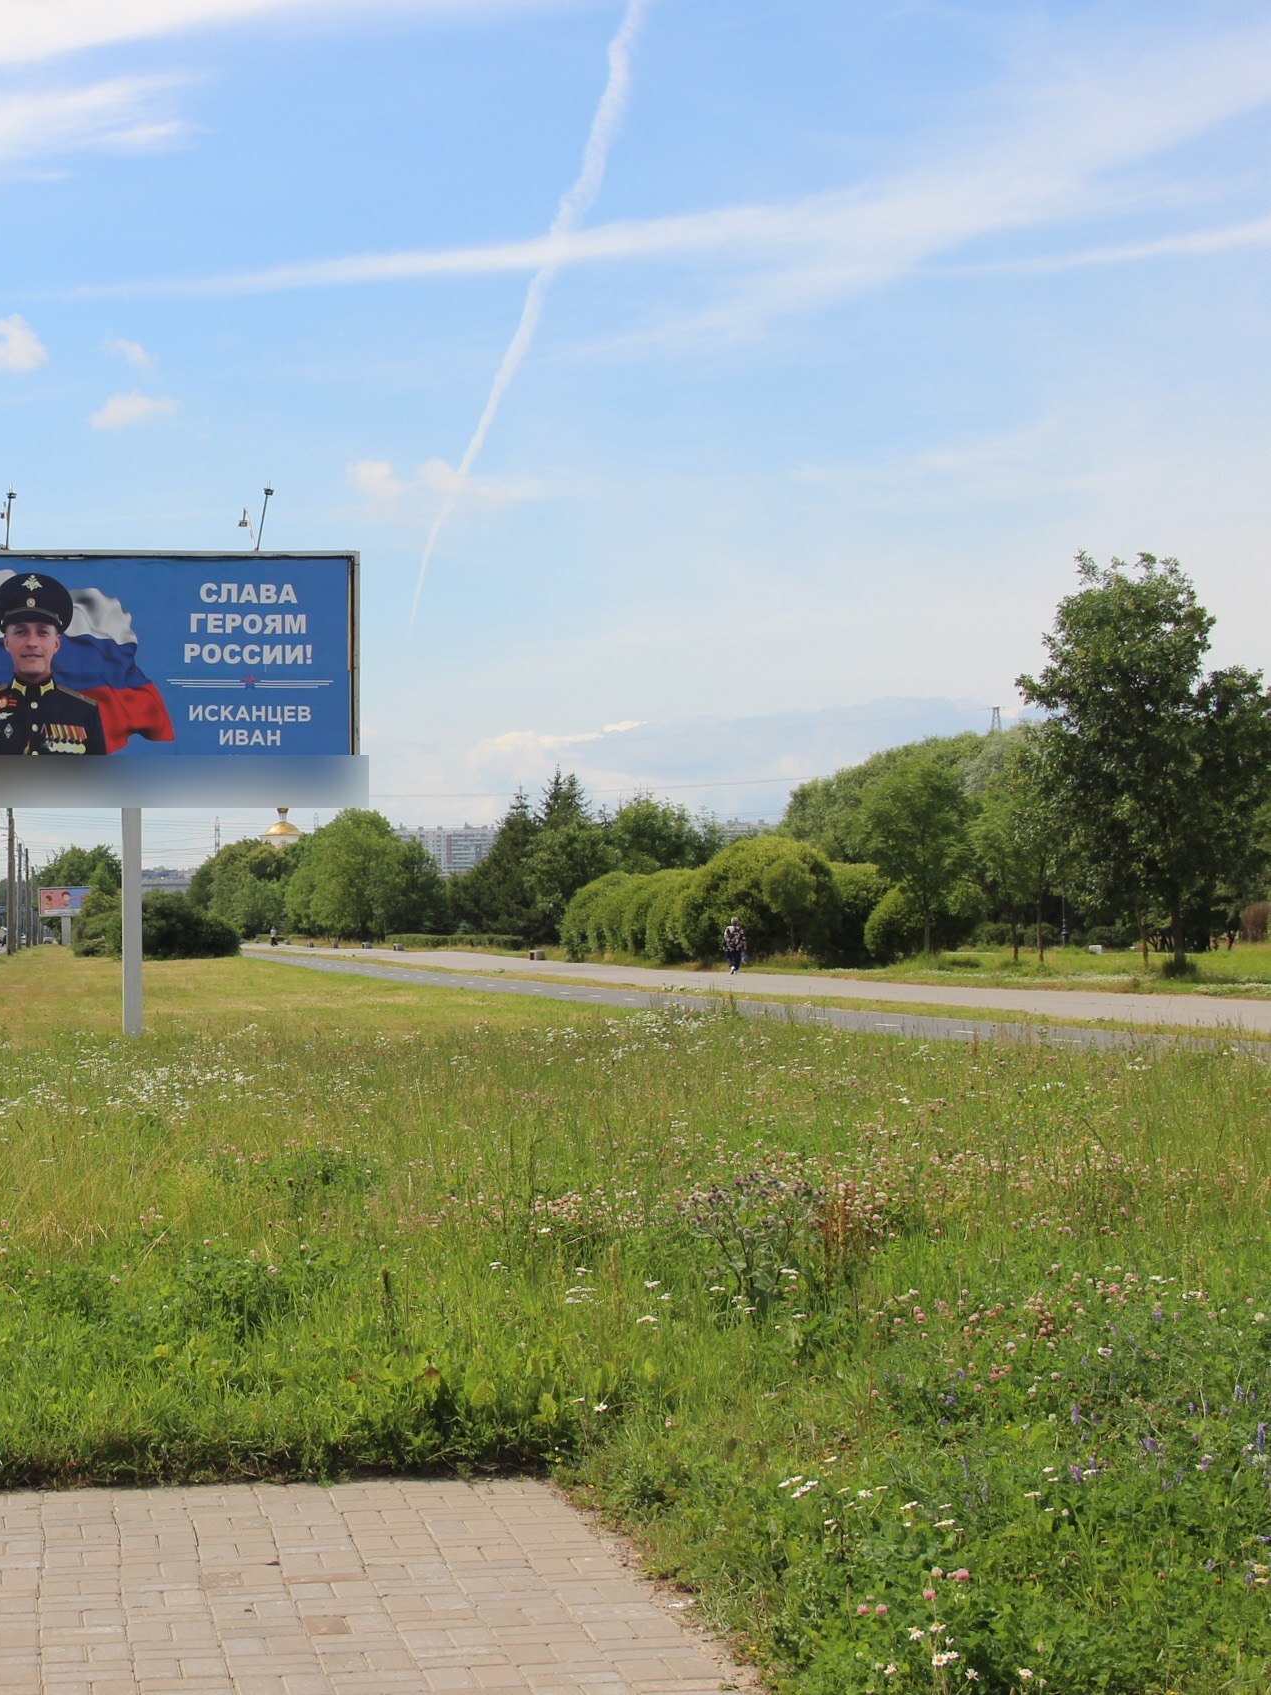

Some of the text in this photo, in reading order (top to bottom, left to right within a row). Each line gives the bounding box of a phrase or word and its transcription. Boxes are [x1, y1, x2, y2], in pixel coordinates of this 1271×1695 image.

[199, 582, 298, 604] СЛАВА
[189, 613, 307, 634] ГЕРОЯМ
[183, 643, 313, 665] РОССИИ!
[188, 704, 312, 725] ИСКАНЦЕВ
[218, 729, 281, 746] ИВАН
